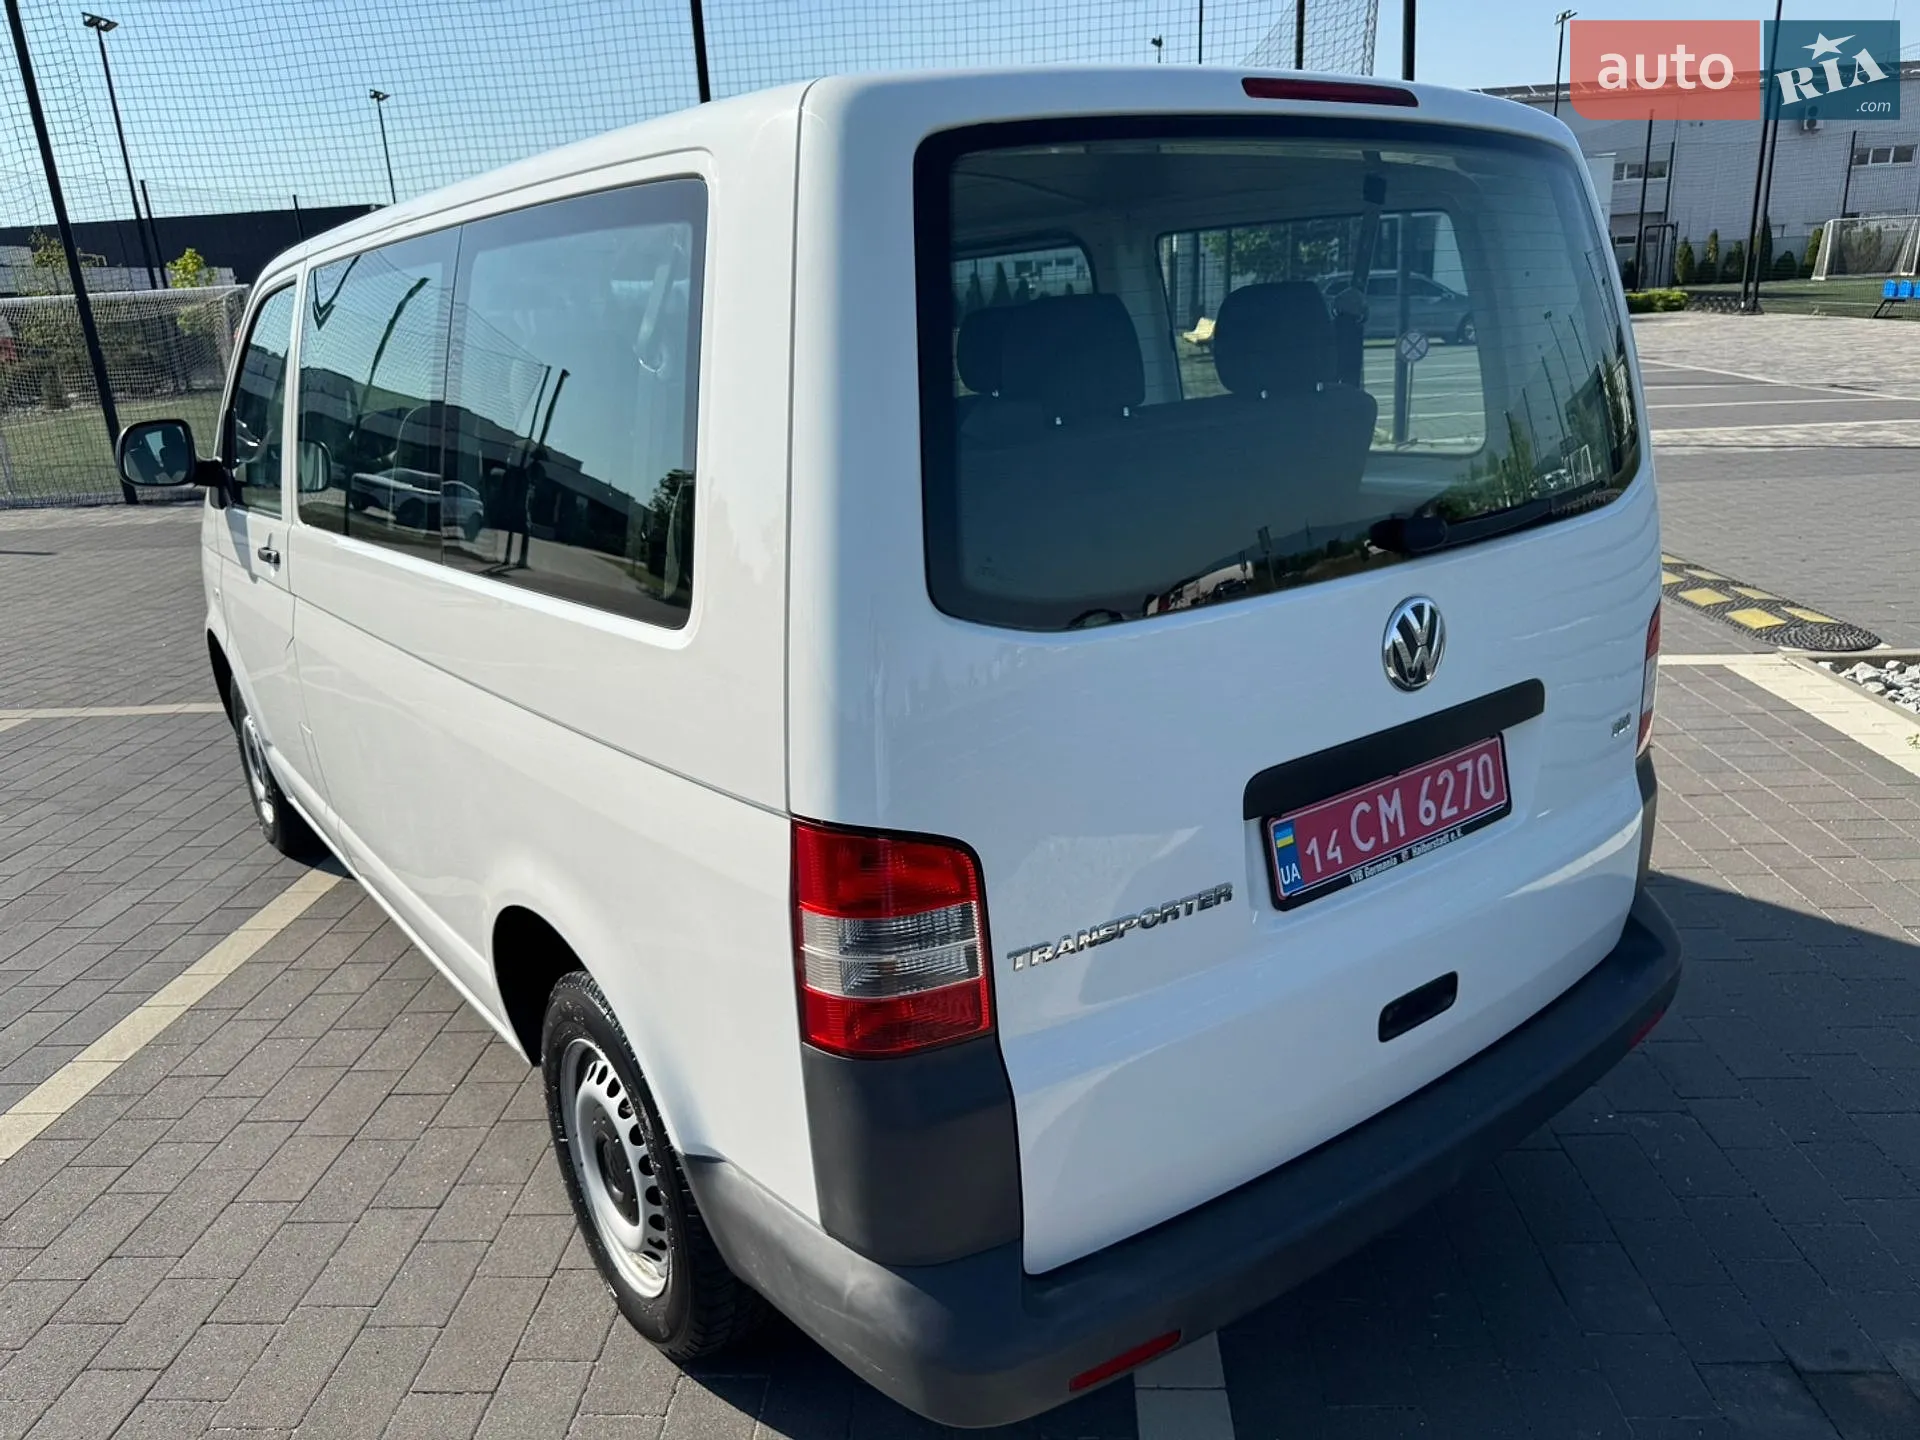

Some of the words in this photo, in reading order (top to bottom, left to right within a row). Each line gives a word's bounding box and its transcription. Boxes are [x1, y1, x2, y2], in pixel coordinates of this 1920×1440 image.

[1385, 597, 1443, 688] VW
[1305, 828, 1343, 873] 14
[1350, 787, 1407, 852] CM
[1417, 753, 1496, 827] 6270
[1280, 862, 1302, 885] UA
[1006, 881, 1234, 972] TRANSPORTER
